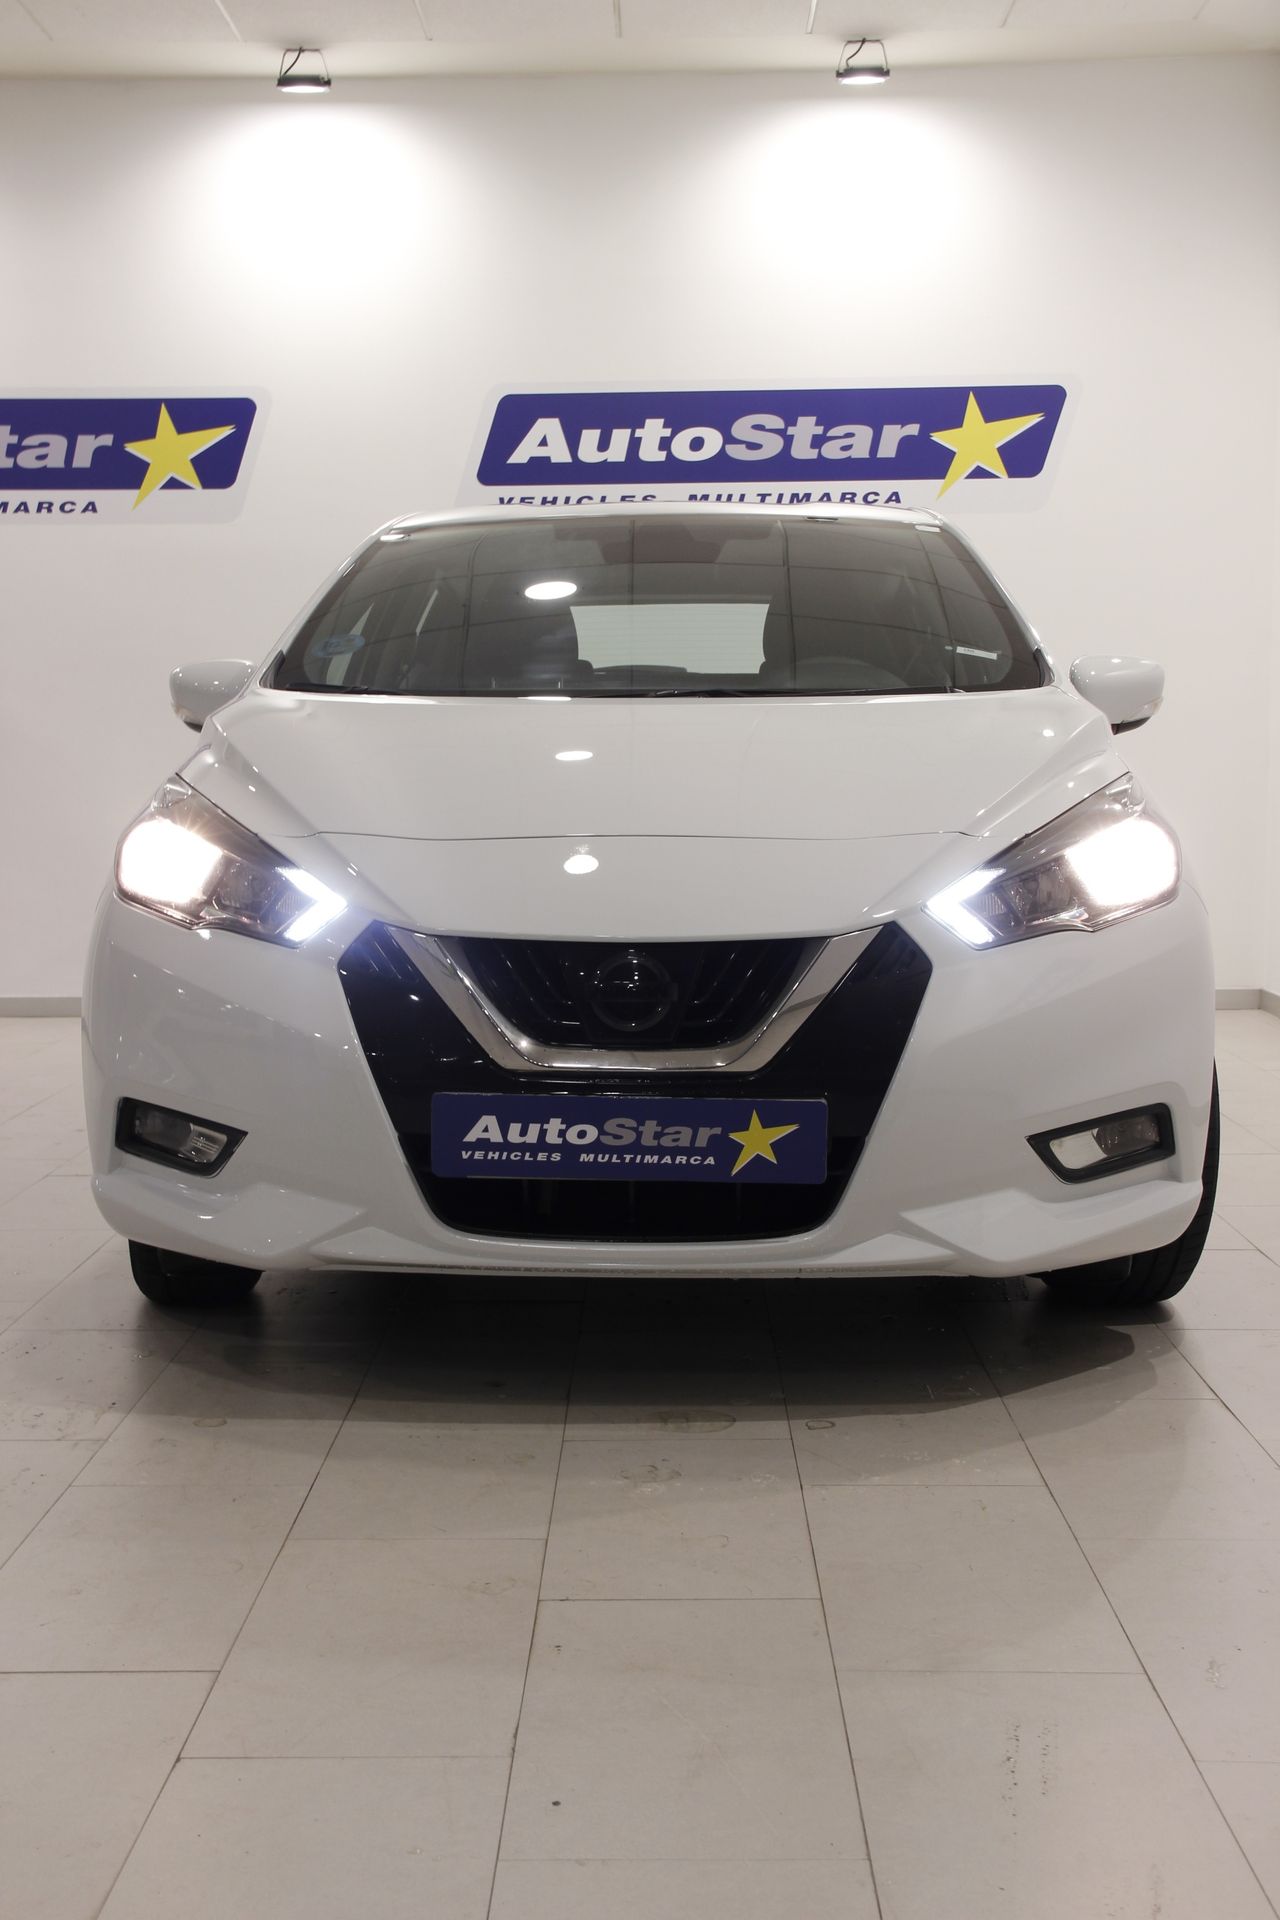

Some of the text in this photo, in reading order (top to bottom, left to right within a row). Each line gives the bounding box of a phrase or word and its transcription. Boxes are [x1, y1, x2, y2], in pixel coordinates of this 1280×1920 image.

[506, 413, 920, 464] AutoStar
[462, 1114, 722, 1148] AutoStar
[461, 1150, 716, 1166] VEHICLES MULTIMARCA
